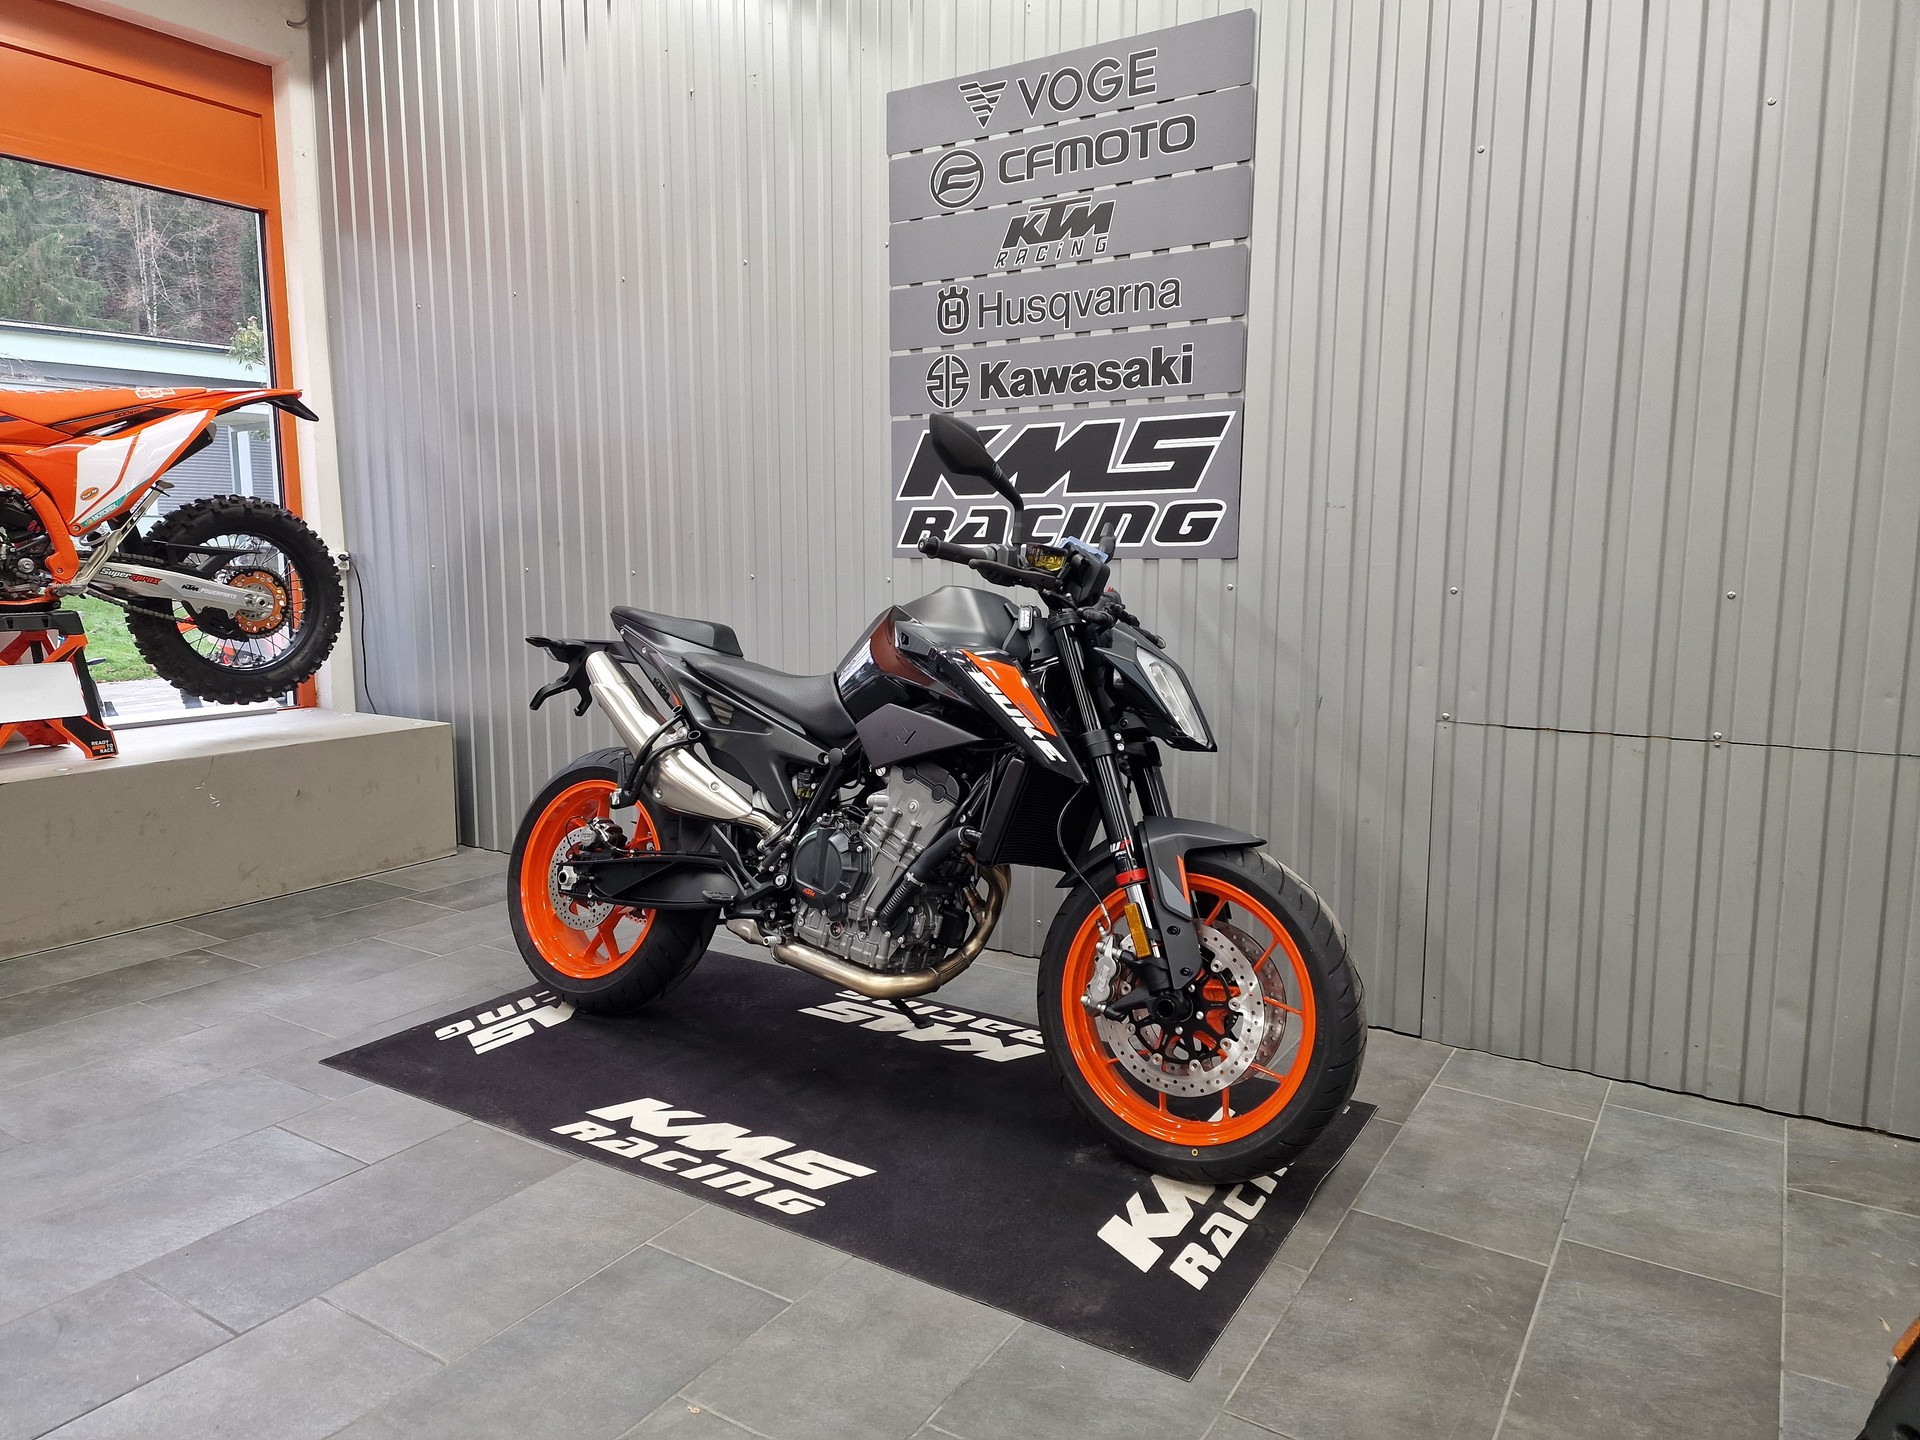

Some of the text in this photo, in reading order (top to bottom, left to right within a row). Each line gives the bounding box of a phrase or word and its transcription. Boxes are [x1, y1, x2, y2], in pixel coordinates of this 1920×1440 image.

[1017, 48, 1158, 118] VOGE
[998, 114, 1197, 184] CFMOTO
[1001, 196, 1116, 249] KTM
[977, 277, 1182, 330] Husqvarna
[979, 343, 1194, 401] Kawasaki
[895, 410, 1236, 501] KMS
[897, 499, 1227, 548] RACING
[968, 670, 1067, 762] DUKE
[549, 1120, 825, 1216] RACING
[585, 1097, 877, 1191] KMS
